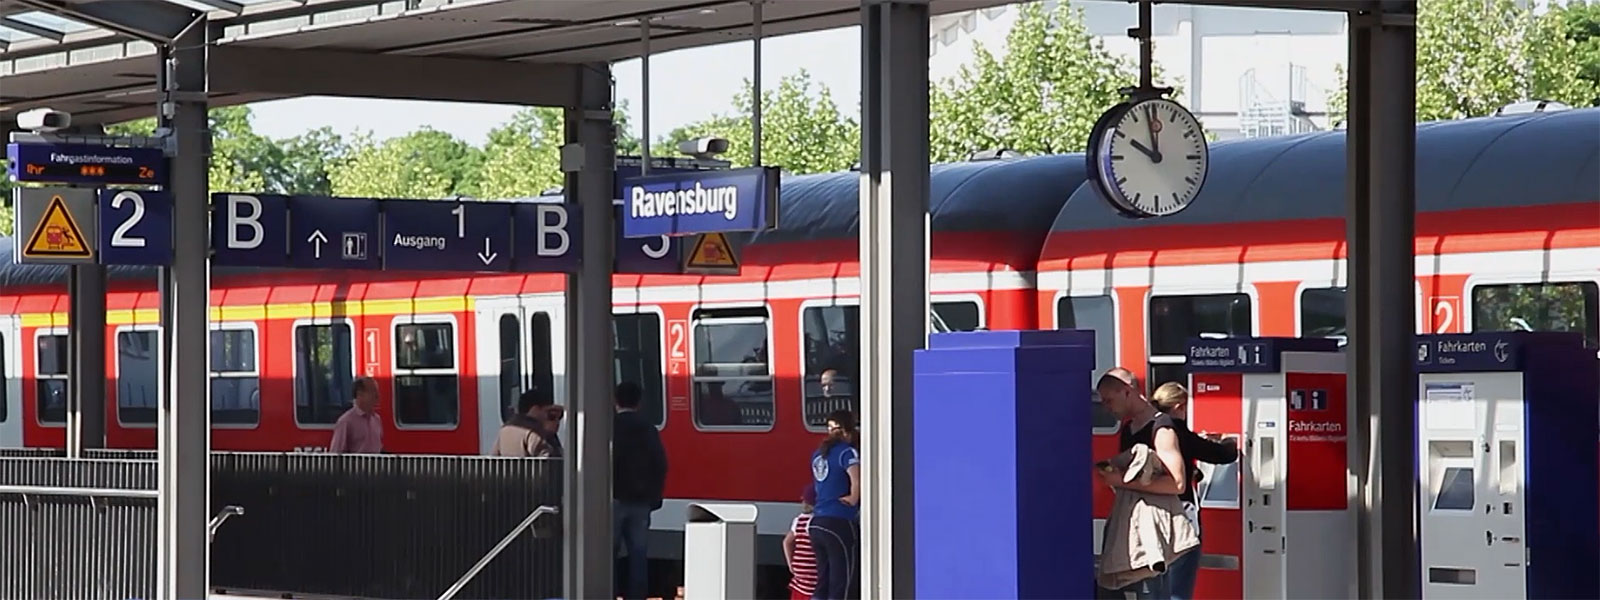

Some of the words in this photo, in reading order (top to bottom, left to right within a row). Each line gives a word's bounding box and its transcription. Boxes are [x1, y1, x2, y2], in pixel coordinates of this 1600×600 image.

[50, 152, 133, 165] Fahrgastinformation
[631, 182, 738, 220] Ravensburg
[111, 190, 146, 247] 2
[227, 194, 265, 249] B
[451, 204, 465, 238] 1
[536, 204, 571, 256] B
[393, 233, 446, 250] Ausgang
[1434, 300, 1454, 334] 2
[366, 331, 376, 363] 1
[671, 323, 684, 358] 2
[1190, 345, 1230, 358] Fahrkarten
[1437, 341, 1487, 352] Fahrkarten
[1288, 420, 1342, 432] Fahrkarten
